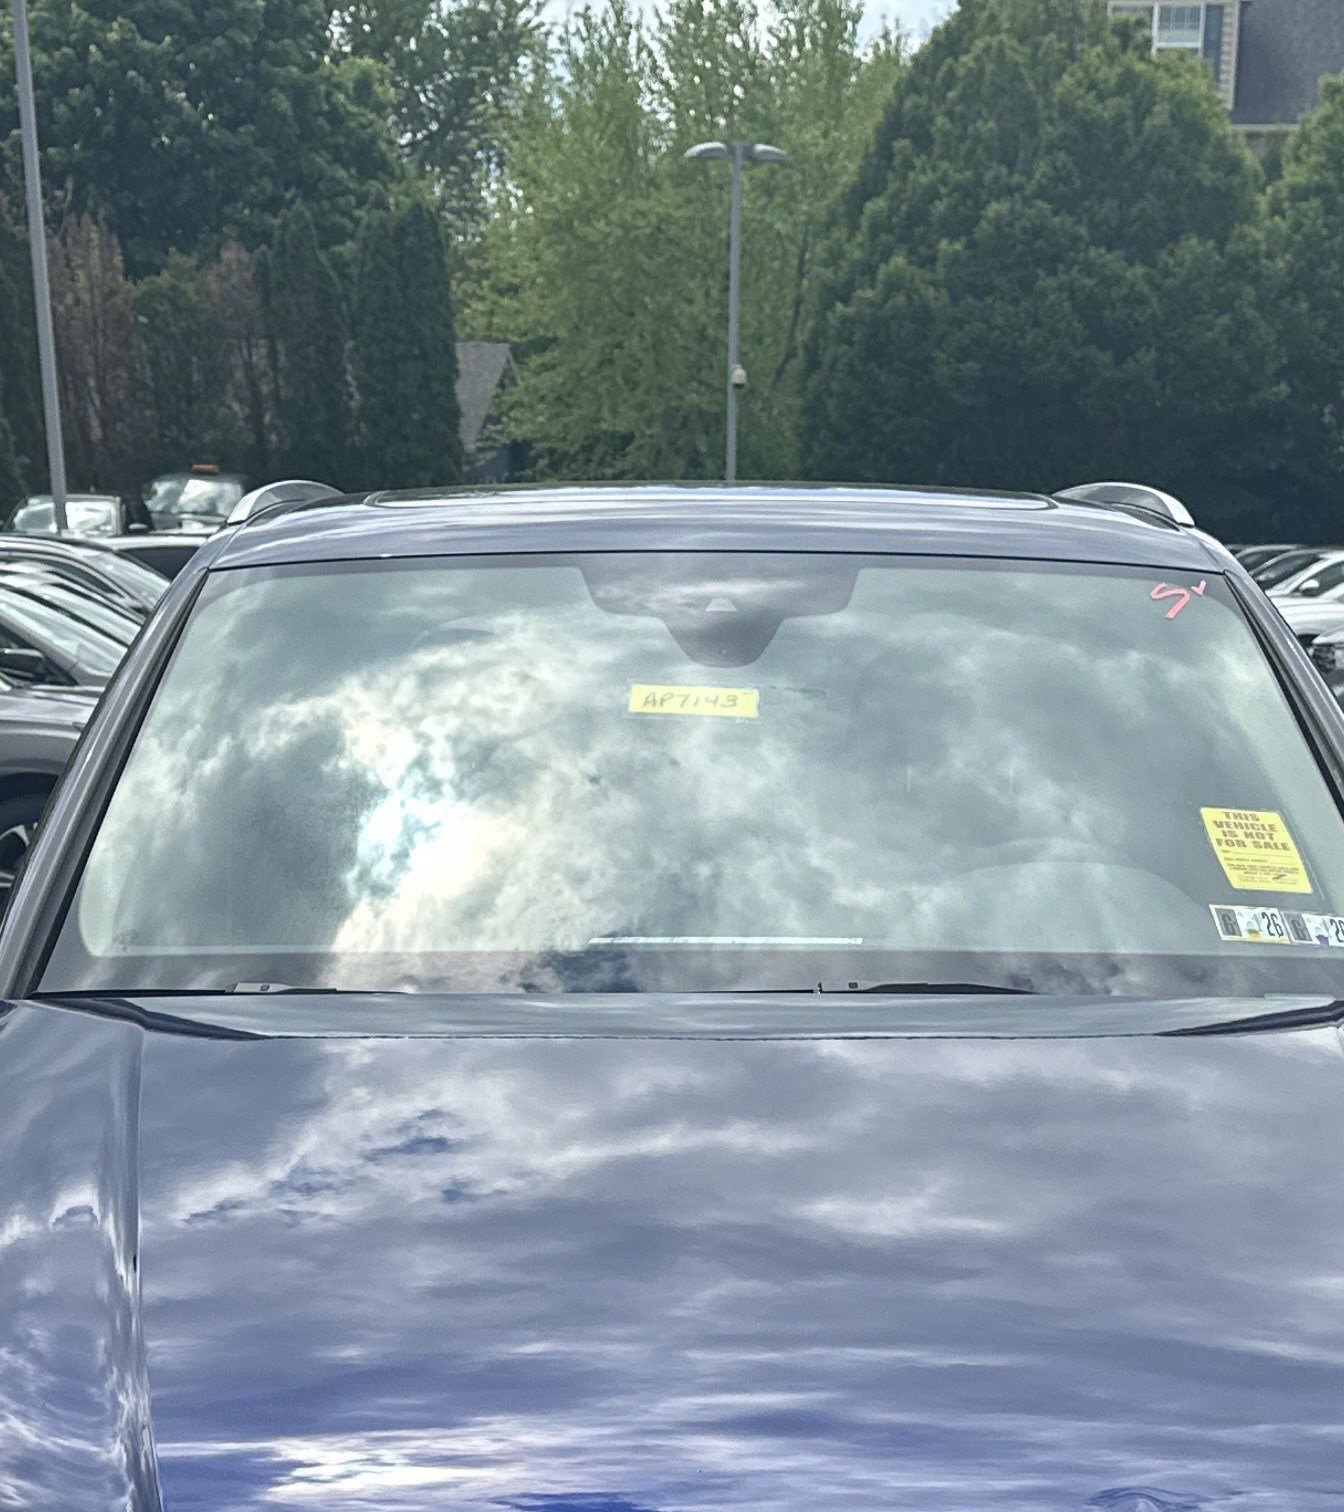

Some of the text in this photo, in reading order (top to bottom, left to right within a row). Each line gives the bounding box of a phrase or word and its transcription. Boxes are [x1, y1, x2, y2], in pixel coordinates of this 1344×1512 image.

[1222, 811, 1260, 822] THIS
[1213, 820, 1279, 833] VEHICLE
[1221, 830, 1275, 842] IS NOT
[1216, 838, 1291, 851] FOR SALE
[1261, 911, 1285, 938] 26
